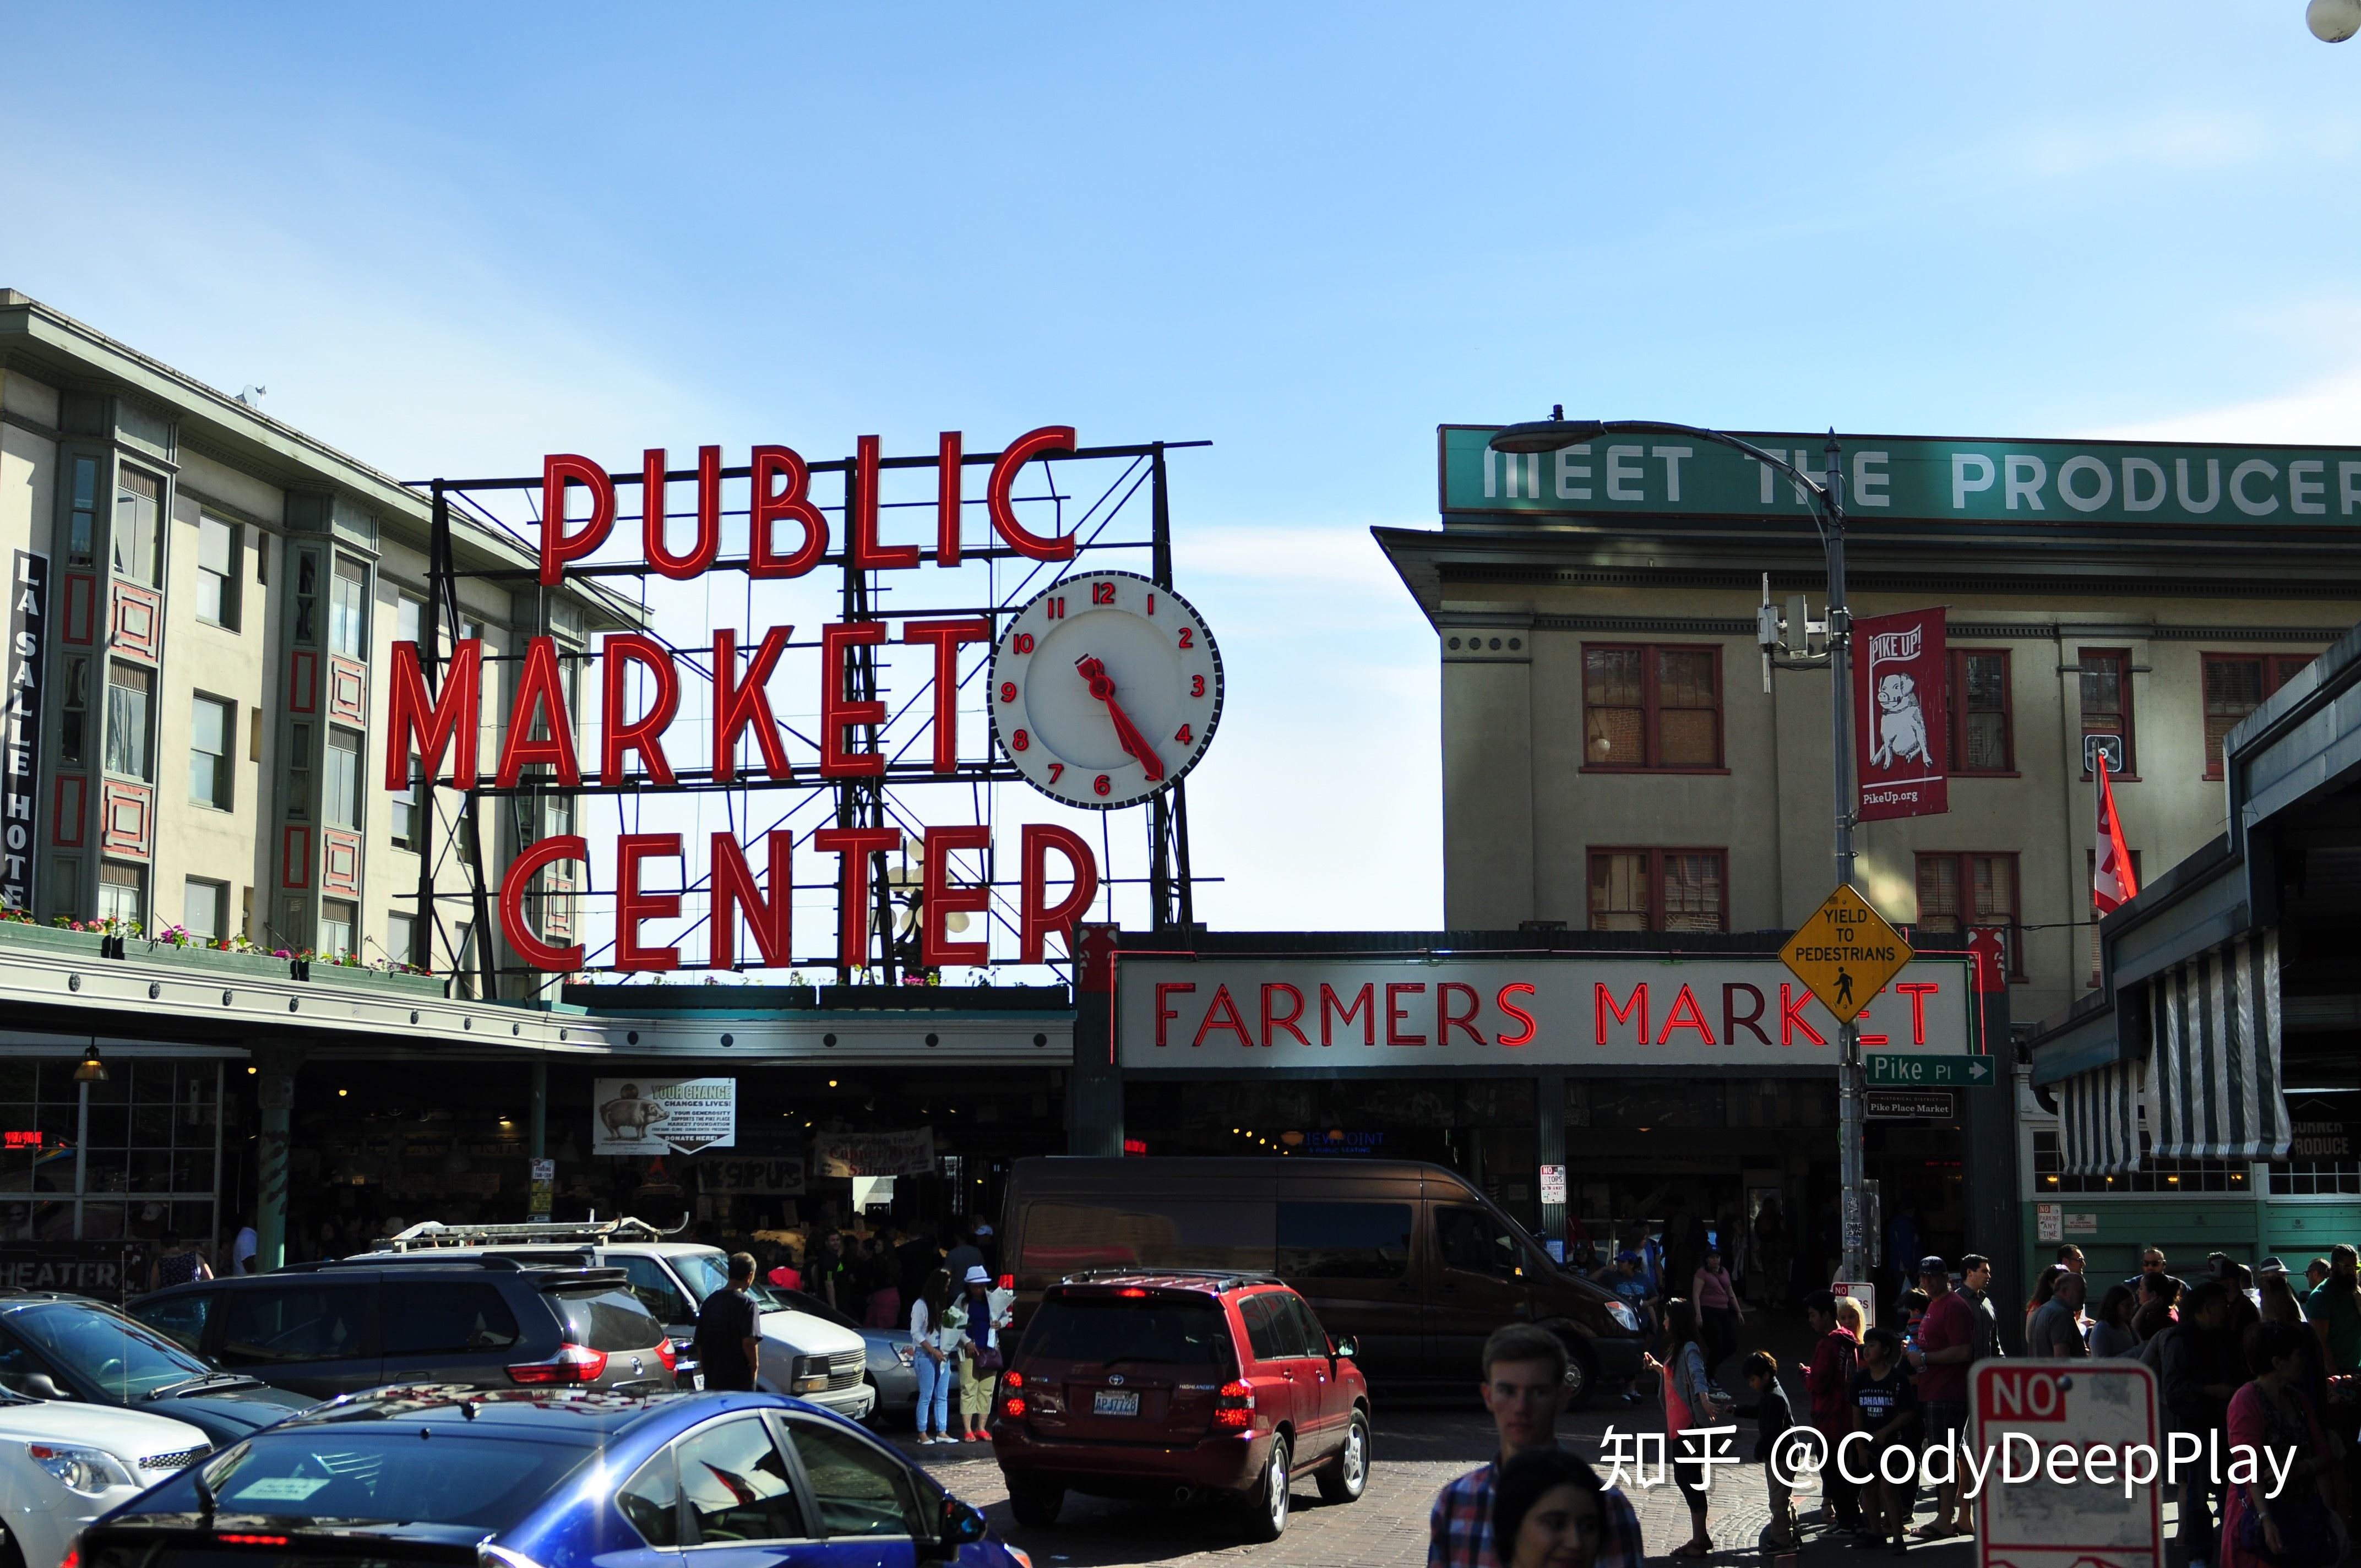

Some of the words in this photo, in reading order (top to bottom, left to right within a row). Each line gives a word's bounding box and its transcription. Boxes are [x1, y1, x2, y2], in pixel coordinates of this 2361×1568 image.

[1484, 445, 1692, 501] MEET
[540, 425, 1078, 586] PUBLIC
[17, 557, 39, 616] LA
[1092, 582, 1115, 604] 12
[1048, 597, 1064, 619] 11
[1147, 594, 1154, 615] 1
[1013, 633, 1033, 654] 10
[1178, 628, 1193, 648] 2
[1872, 636, 1897, 662] PIKE
[1901, 630, 1921, 656] UP!
[1000, 682, 1017, 703] 9
[1190, 674, 1204, 697] 3
[9, 631, 36, 776] SALLE
[385, 617, 989, 791] MARKET
[1012, 729, 1029, 751] 8
[1175, 724, 1193, 744] 4
[1048, 764, 1064, 784] 7
[1094, 775, 1110, 796] 6
[1863, 791, 1918, 805] PikeUp.org
[498, 824, 1099, 972] CENTER
[1824, 910, 1867, 923] YIELD
[1836, 928, 1854, 942] TO
[1796, 947, 1895, 961] PEDESTRIANS
[1155, 983, 1536, 1047] FARMERS
[1875, 1057, 1922, 1080] Pike
[651, 1085, 683, 1099] YOUR
[684, 1085, 731, 1099] CHANGE
[1917, 1104, 1949, 1113] Market
[2294, 1137, 2350, 1155] RODUCE
[1095, 1398, 1136, 1412] APJ7728
[1859, 1396, 1895, 1406] BAHAMAS
[1993, 1373, 2058, 1417] NO
